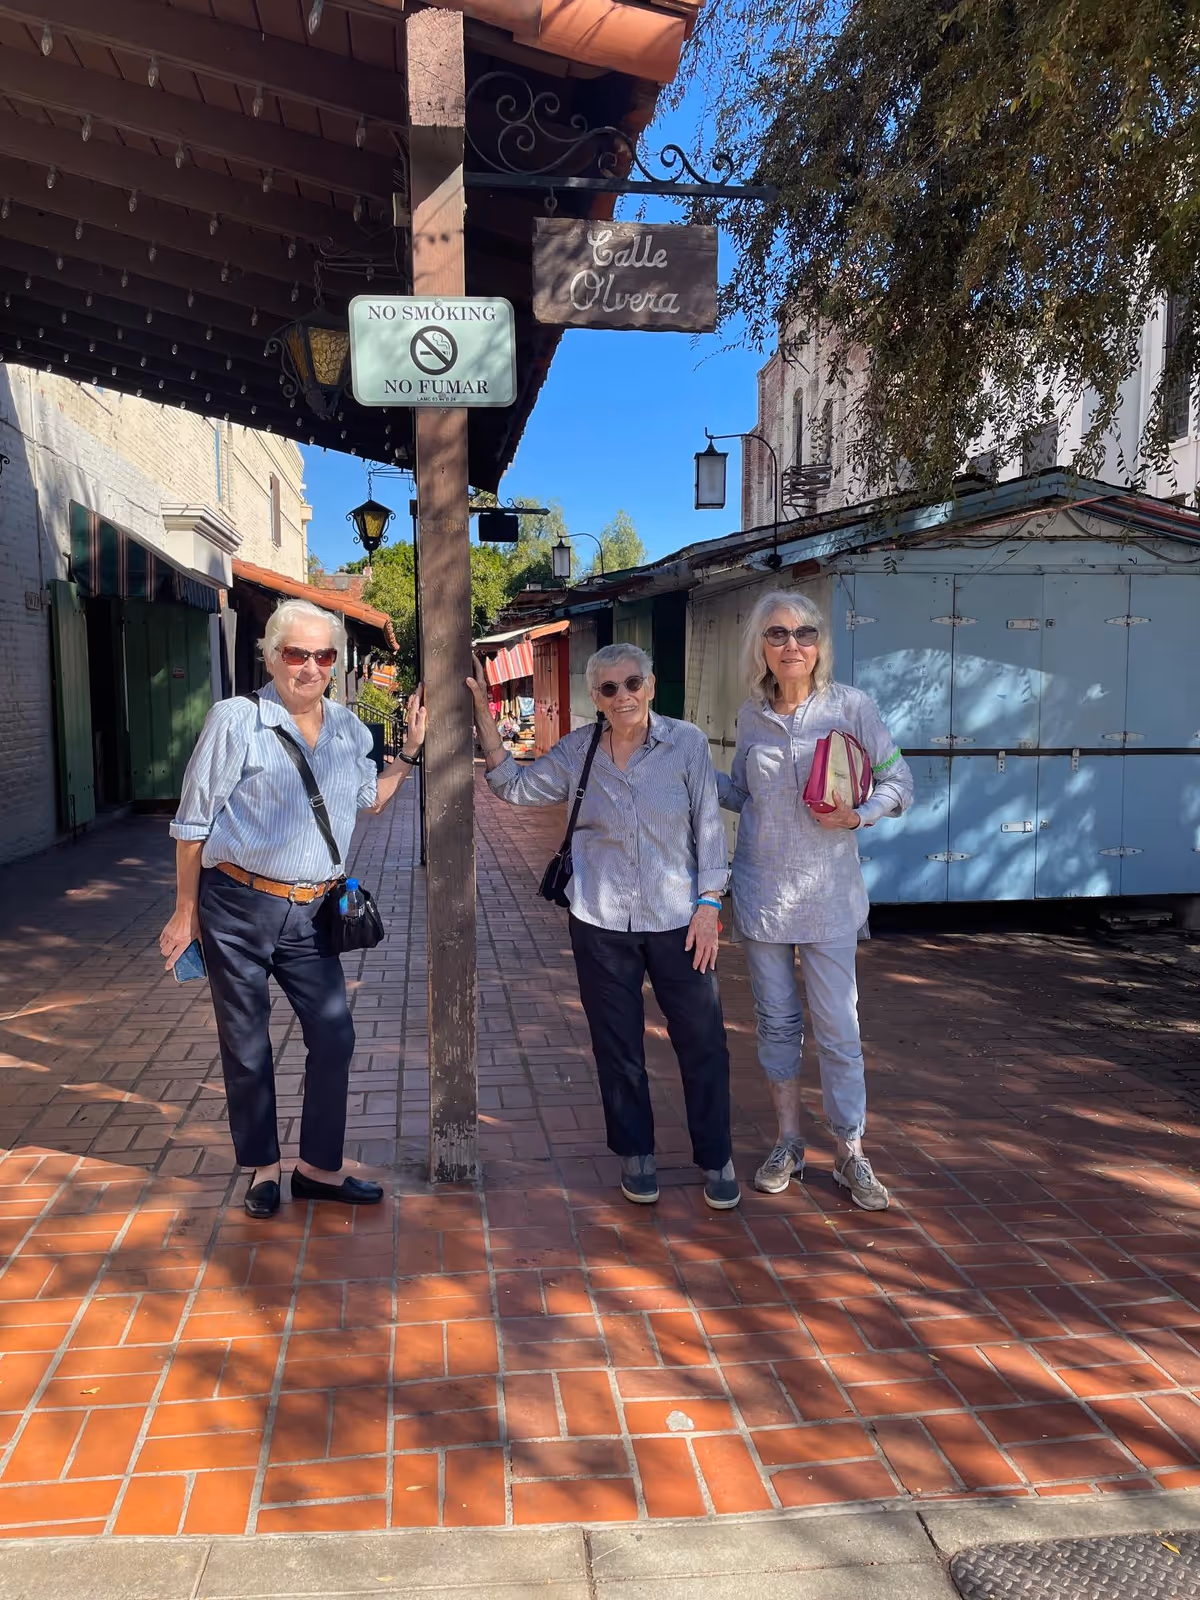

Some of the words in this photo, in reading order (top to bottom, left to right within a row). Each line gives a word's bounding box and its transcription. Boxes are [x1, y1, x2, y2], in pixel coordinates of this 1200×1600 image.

[587, 229, 668, 268] Calle
[570, 269, 681, 314] Olvera
[368, 305, 396, 320] NO
[402, 305, 496, 321] SMOKING
[384, 379, 413, 394] NO
[418, 379, 489, 394] FUMAR
